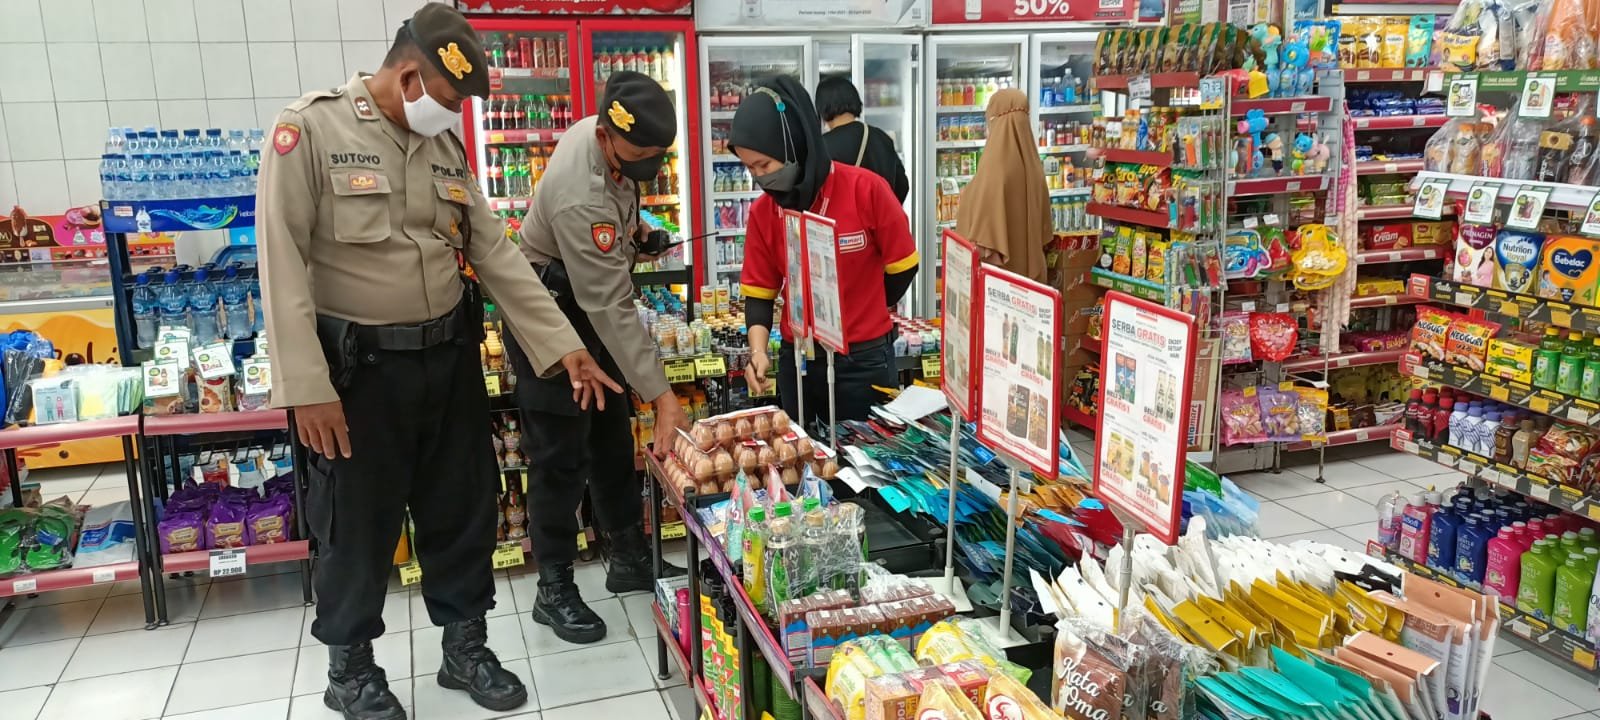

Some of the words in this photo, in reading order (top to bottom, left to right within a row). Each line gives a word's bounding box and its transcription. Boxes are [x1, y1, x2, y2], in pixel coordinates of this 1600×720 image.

[1014, 0, 1070, 15] 50%
[331, 152, 380, 165] SUTOYO
[431, 164, 465, 178] POLR
[1374, 231, 1398, 243] Cream
[1503, 243, 1533, 255] Nutrilon
[1554, 255, 1585, 267] Bebelac
[1582, 288, 1592, 302] 4
[1112, 319, 1135, 335] SERBA
[1136, 327, 1166, 348] GRATIS
[1450, 330, 1483, 346] NEOGURI
[213, 568, 221, 576] RP
[1061, 657, 1100, 697] Kata
[1065, 686, 1111, 720] Oma
